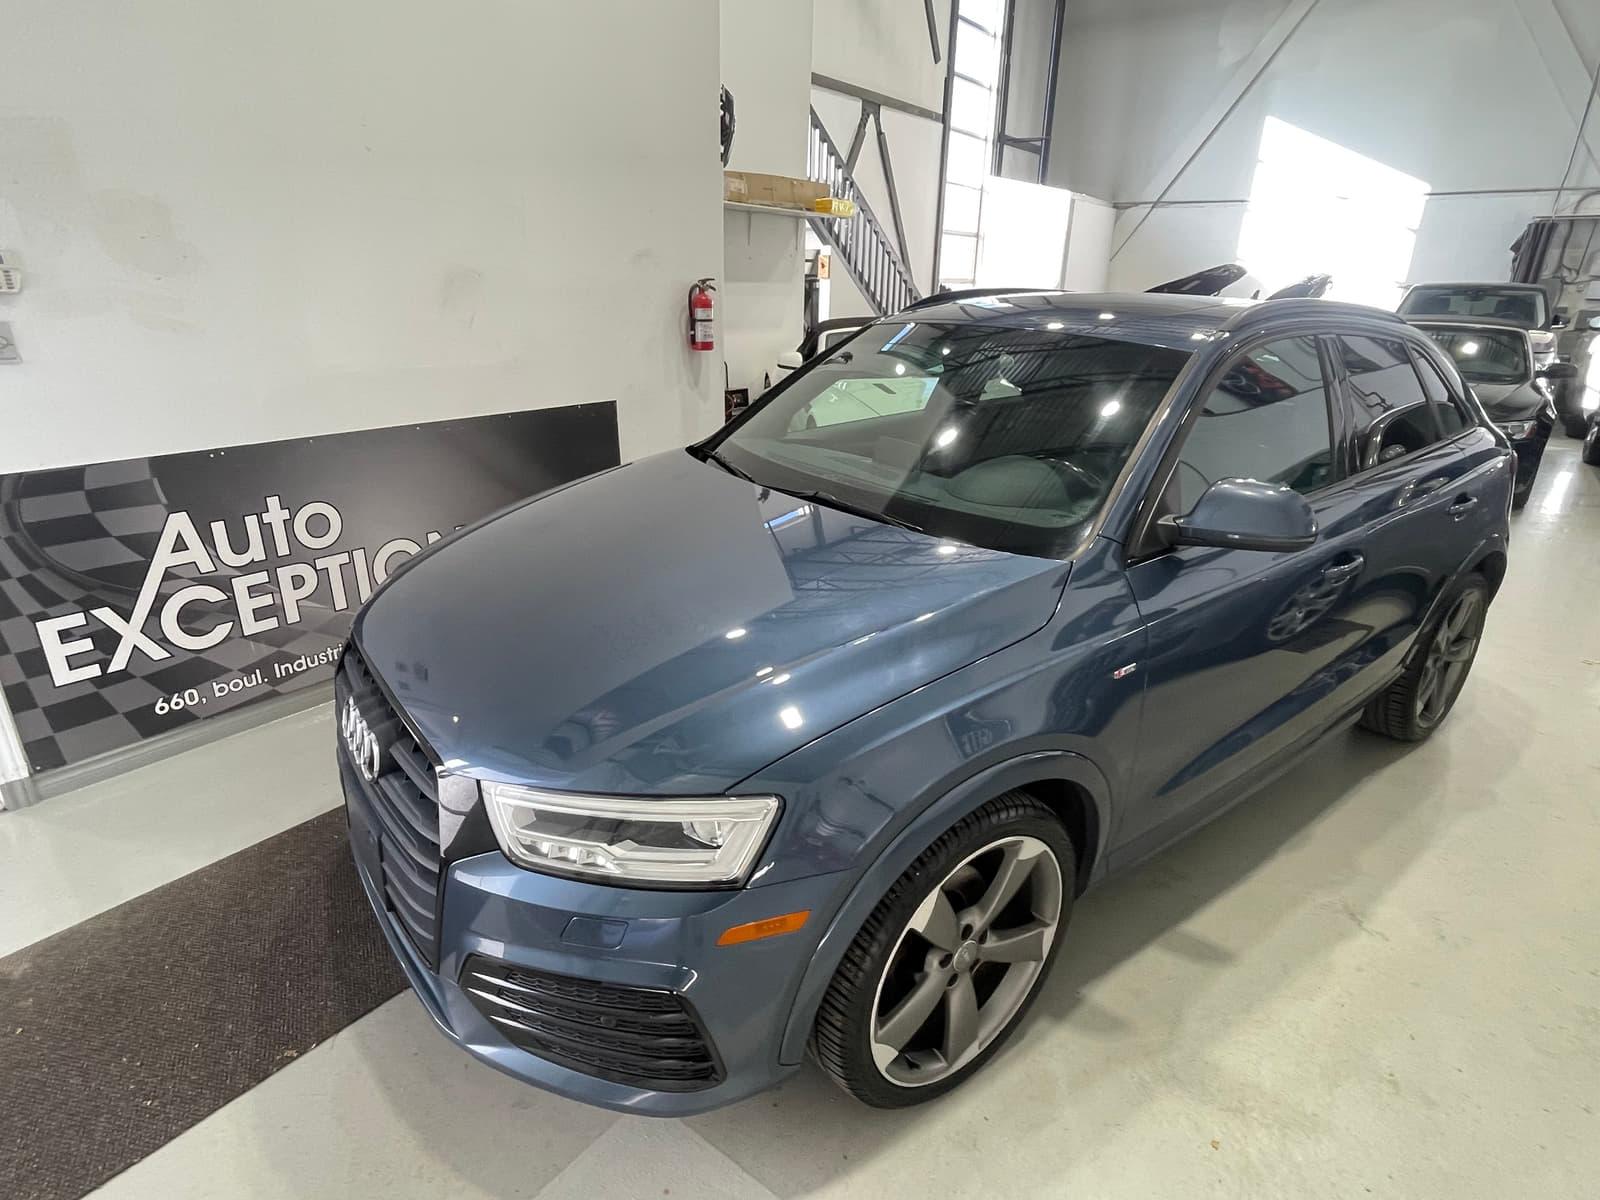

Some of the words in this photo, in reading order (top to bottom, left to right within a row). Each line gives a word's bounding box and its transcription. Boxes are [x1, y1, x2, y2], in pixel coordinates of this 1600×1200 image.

[147, 494, 343, 574] Auto
[35, 524, 466, 687] EXCEPTIO
[154, 688, 207, 715] 660,
[212, 669, 268, 698] boul.
